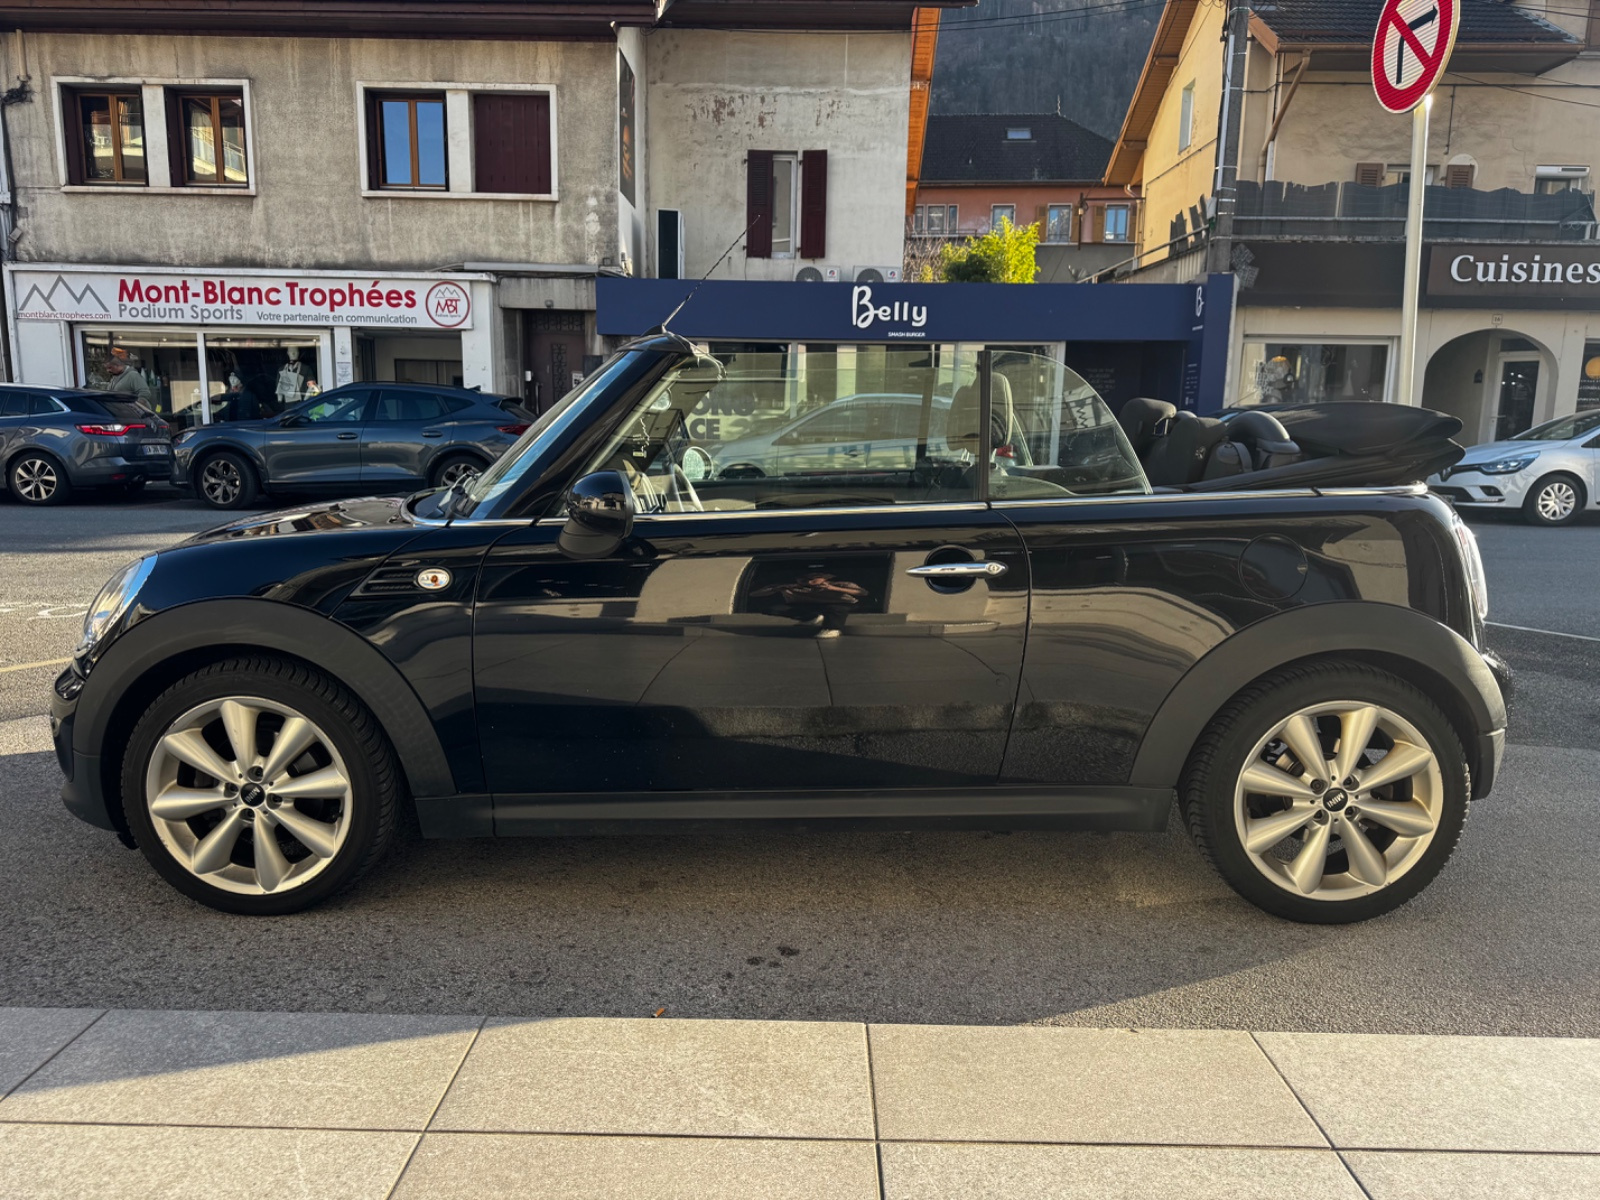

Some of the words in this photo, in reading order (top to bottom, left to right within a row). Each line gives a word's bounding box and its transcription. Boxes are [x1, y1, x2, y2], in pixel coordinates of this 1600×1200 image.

[1450, 254, 1600, 284] Cuisines
[118, 279, 282, 306] Mont-Blanc
[285, 280, 417, 312] Trophées
[852, 285, 927, 328] Belly
[17, 310, 112, 320] montblanctrophees.com
[119, 303, 185, 319] Podium
[190, 304, 243, 322] Sports
[256, 311, 282, 321] Votre
[283, 312, 330, 323] partenaire
[332, 314, 344, 322] en
[345, 313, 418, 324] communication
